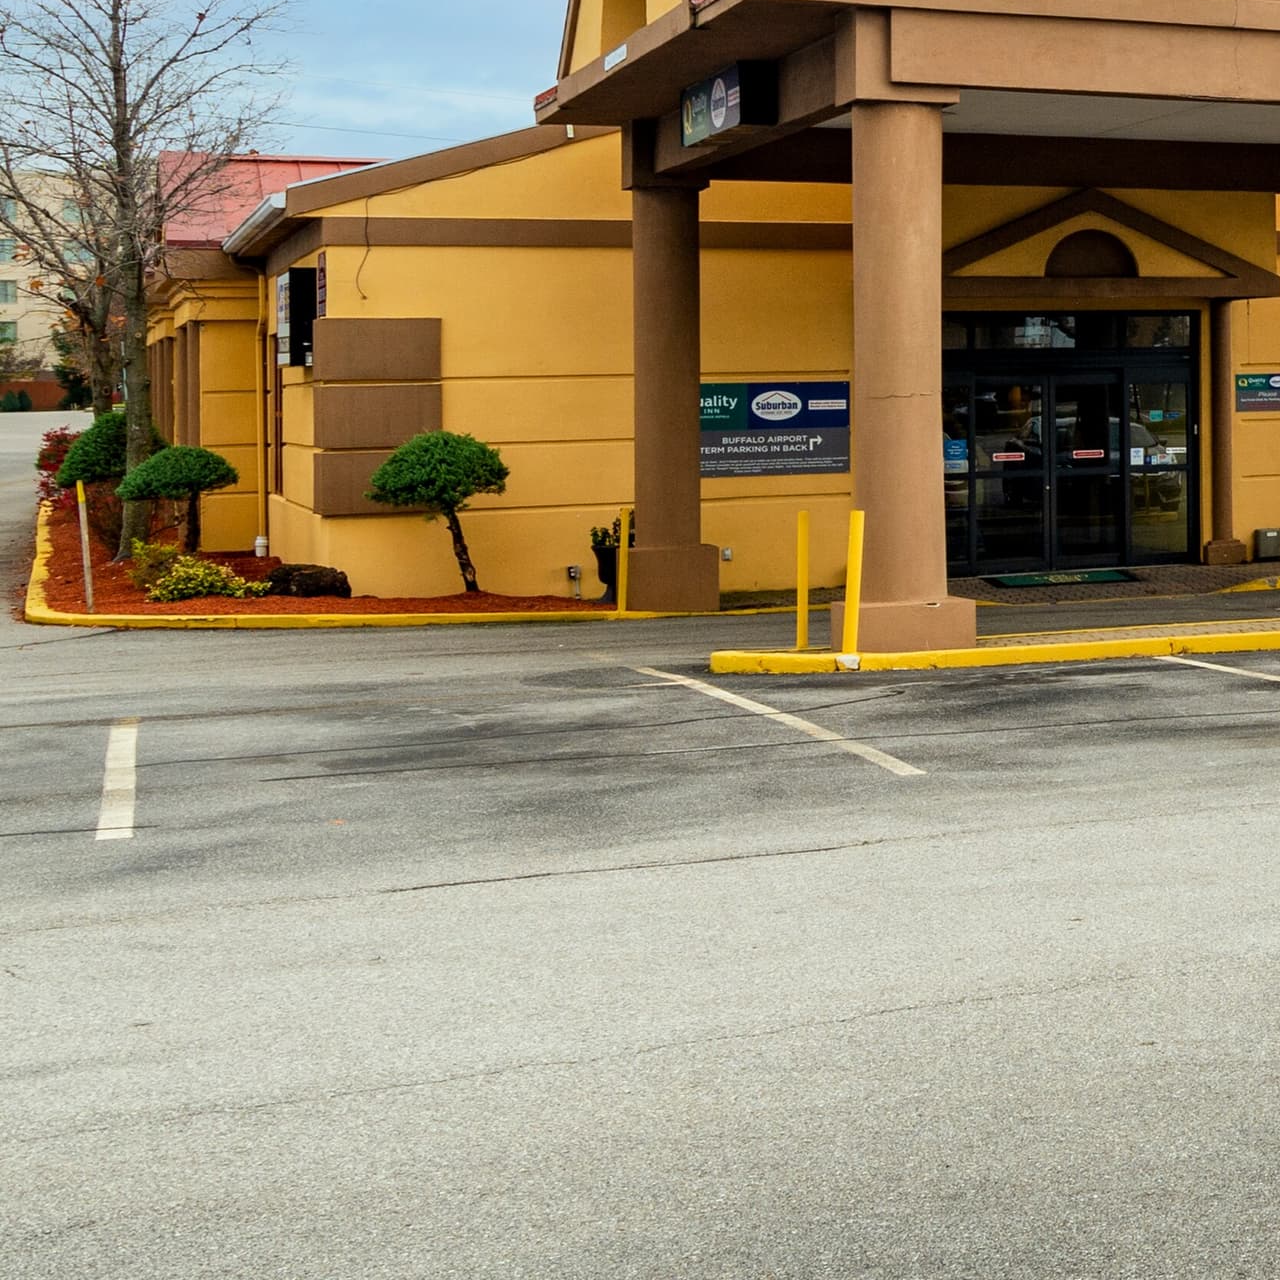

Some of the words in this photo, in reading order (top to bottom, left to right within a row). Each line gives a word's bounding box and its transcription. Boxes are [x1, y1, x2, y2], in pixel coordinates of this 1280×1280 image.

[755, 401, 798, 410] Suburban
[722, 435, 766, 445] BUFFALO
[767, 434, 808, 443] AIRPORT
[727, 445, 768, 453] PARKING
[771, 444, 780, 452] IN
[782, 444, 808, 452] BACK
